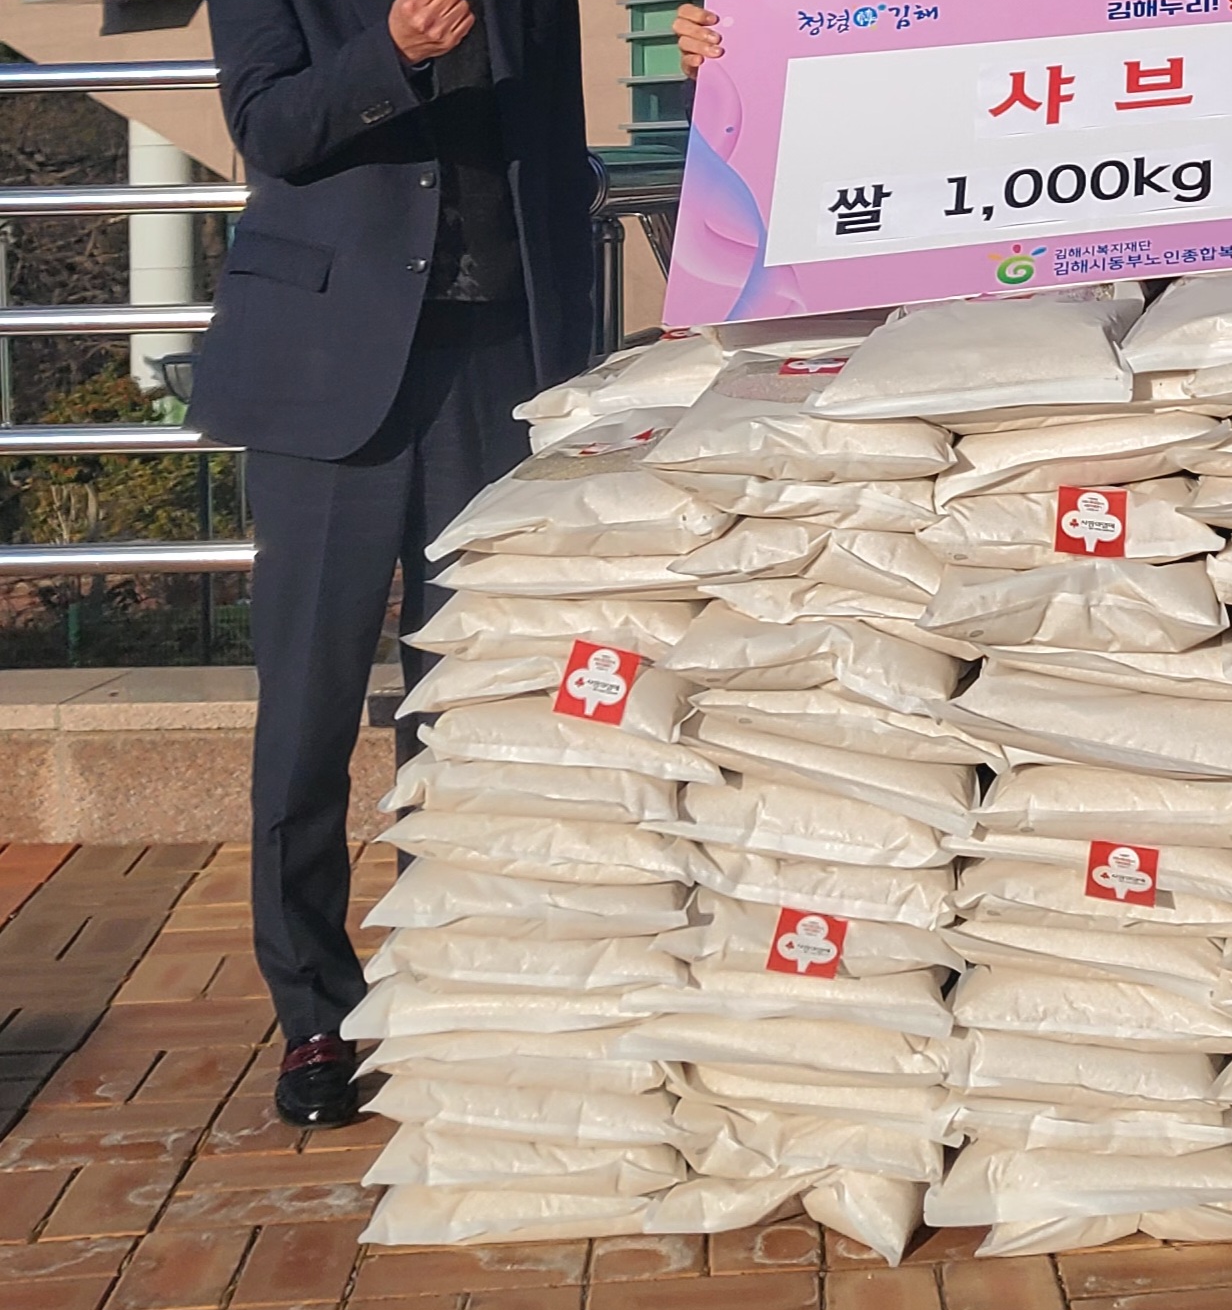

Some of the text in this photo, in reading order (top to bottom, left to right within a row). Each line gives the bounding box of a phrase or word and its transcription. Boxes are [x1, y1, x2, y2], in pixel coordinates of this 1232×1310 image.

[888, 4, 939, 30] 김해
[828, 184, 893, 236] 쌀
[944, 156, 1212, 222] 1,000kg
[1055, 240, 1152, 260] 김해시복지재단
